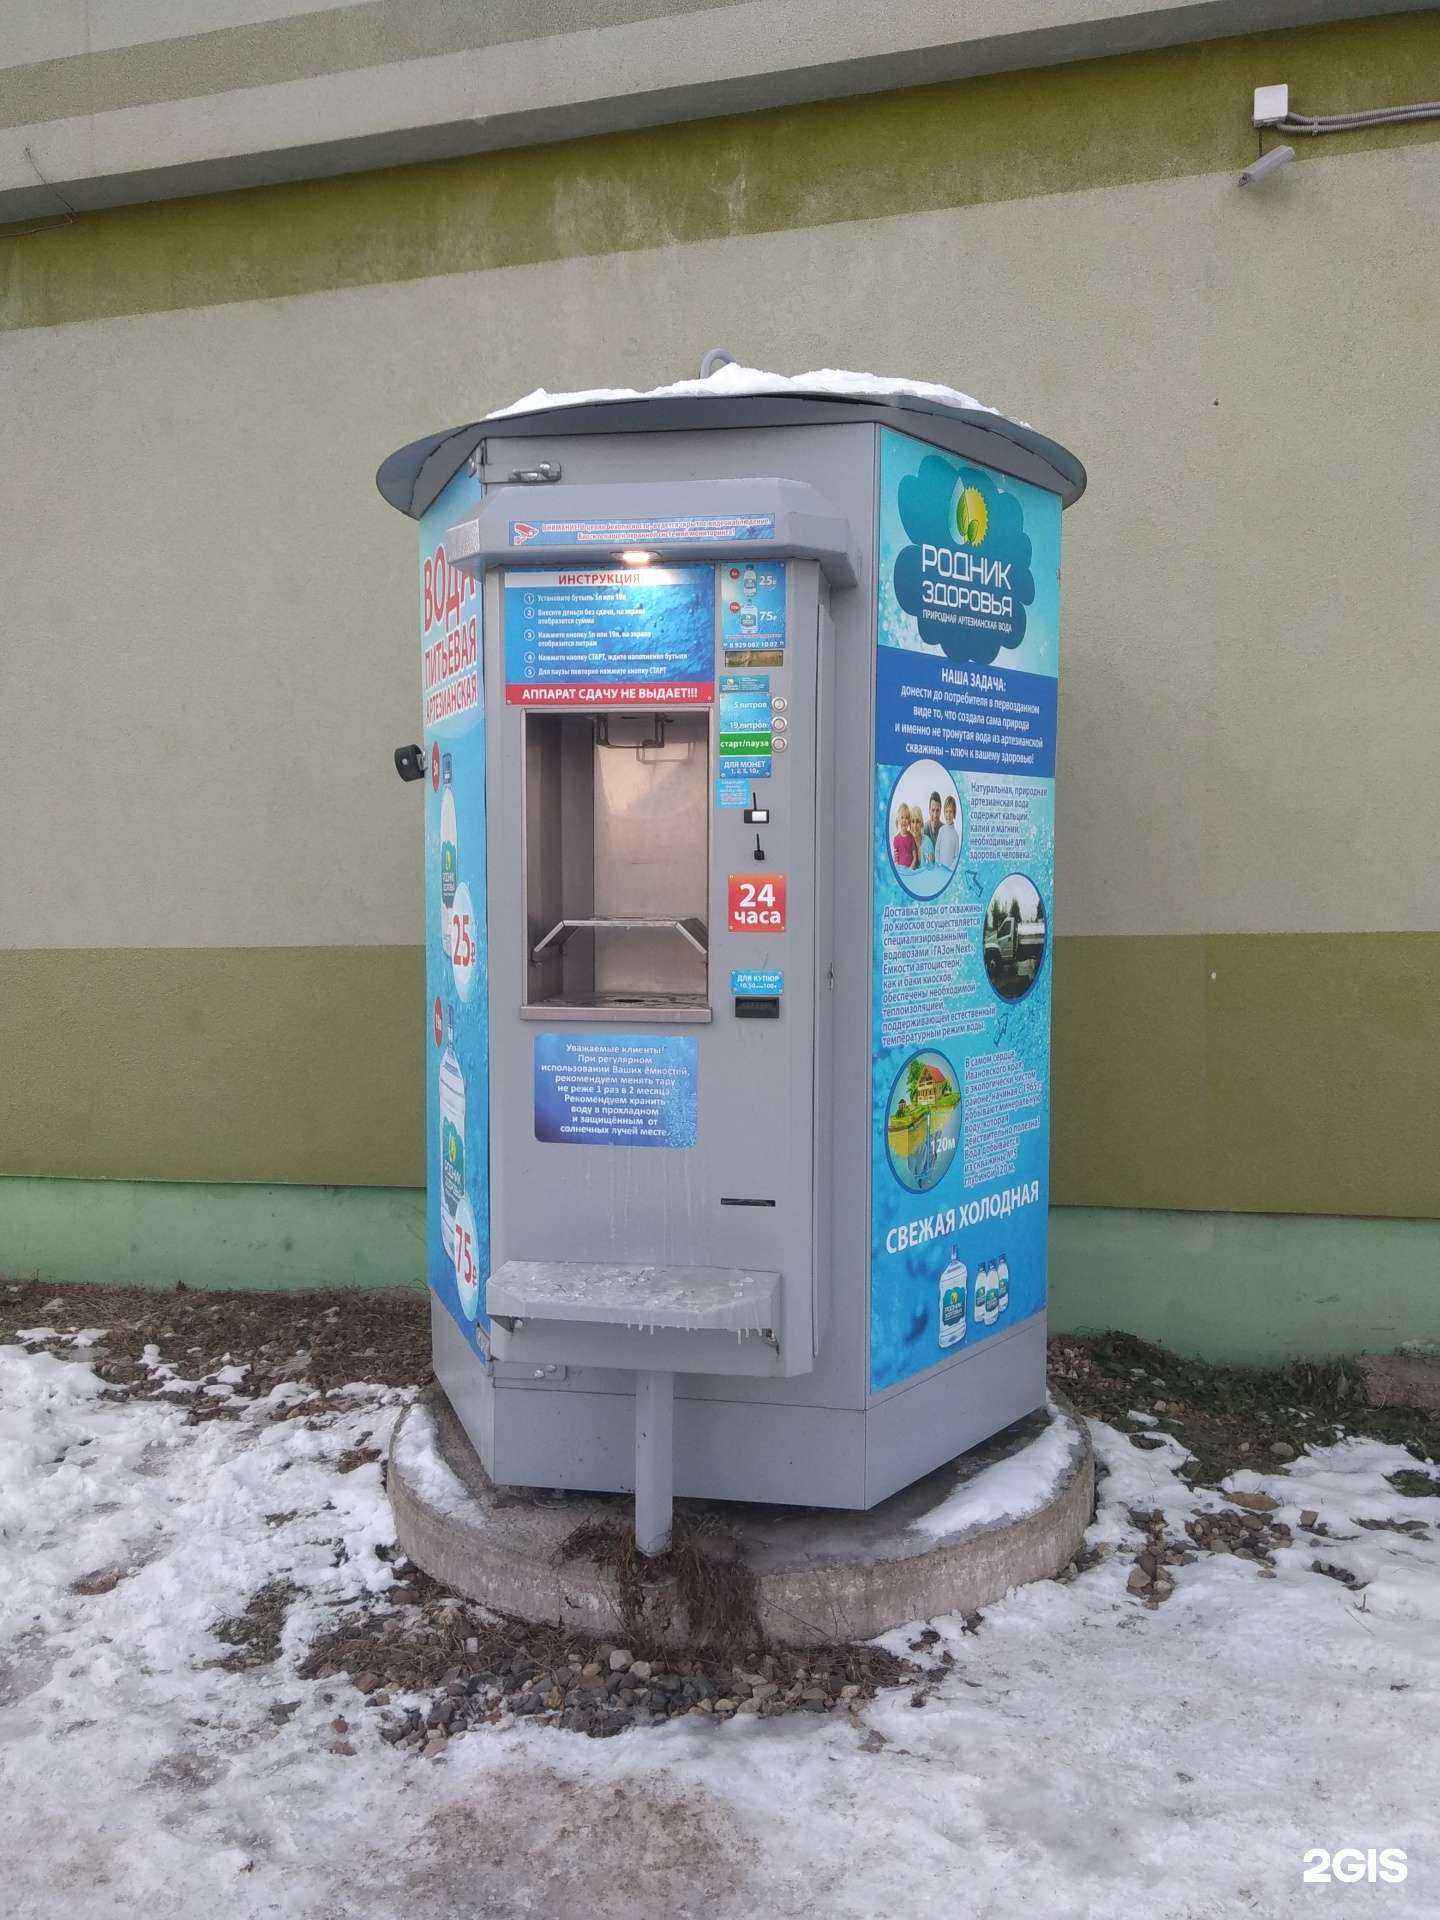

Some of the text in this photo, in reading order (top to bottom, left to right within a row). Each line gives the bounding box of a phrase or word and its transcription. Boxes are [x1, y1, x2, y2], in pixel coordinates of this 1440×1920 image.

[922, 544, 1011, 590] РОДНИК
[558, 574, 640, 585] ИНСТРУКЦИЯ
[922, 580, 1012, 618] ЗДОРОВЬЯ
[922, 610, 1012, 633] ПРИРОДНАЯ АРТЕЗИАНСКАЯ ВОДА
[425, 618, 477, 690] ПИТЬЕВАЯ
[942, 668, 1007, 692] НАША ЗАДАЧА:
[425, 674, 478, 725] АРТЕЗИАНСКАЯ
[522, 688, 698, 701] АППАРАТ СДАЧУ НЕ ВЫДАЕТ!!!
[901, 686, 932, 698] донести
[933, 690, 943, 702] до
[944, 691, 988, 707] потребителя
[994, 700, 1040, 714] первозданном
[740, 702, 768, 710] литров
[913, 706, 1030, 731] виде то, что создала сама природа
[738, 722, 768, 730] литров
[901, 724, 930, 736] именно
[932, 727, 942, 736] не
[942, 728, 975, 742] тронутая
[975, 730, 992, 744] вода
[992, 734, 1000, 743] из
[720, 740, 770, 748] старт/пауза
[906, 743, 944, 756] скважины
[950, 748, 968, 758] ключ
[975, 750, 1000, 764] вашему
[1001, 753, 1035, 766] здоровью!
[971, 782, 1048, 798] Натуральная, природная
[970, 798, 1028, 809] артезианская вода
[970, 812, 1000, 821] содержит
[970, 836, 1014, 846] необходимые
[970, 851, 1000, 862] здоровья
[738, 883, 776, 908] 24
[734, 910, 782, 924] часа
[884, 906, 918, 918] Доставка
[950, 904, 983, 914] скважины
[884, 922, 894, 932] до
[894, 922, 925, 932] киосков
[884, 932, 968, 947] специализированными
[883, 949, 930, 961] водовозами
[884, 964, 914, 975] Емкости
[738, 974, 752, 982] ДЛЯ
[884, 980, 896, 989] как
[566, 1044, 664, 1055] Уважаемые клиенты!
[578, 1054, 653, 1066] При регулярном
[542, 1064, 642, 1074] использовании Ваших
[555, 1075, 618, 1086] рекомендуем
[655, 1079, 676, 1088] тару
[571, 1087, 597, 1095] реже
[604, 1087, 620, 1096] раз
[564, 1094, 666, 1106] Рекомендуем хранить
[571, 1106, 592, 1116] воду
[602, 1108, 659, 1118] прохладном
[581, 1116, 644, 1126] защищённым
[560, 1126, 638, 1137] солнечных лучей
[886, 1180, 1039, 1254] СВЕЖАЯ ХОЛОДНАЯ
